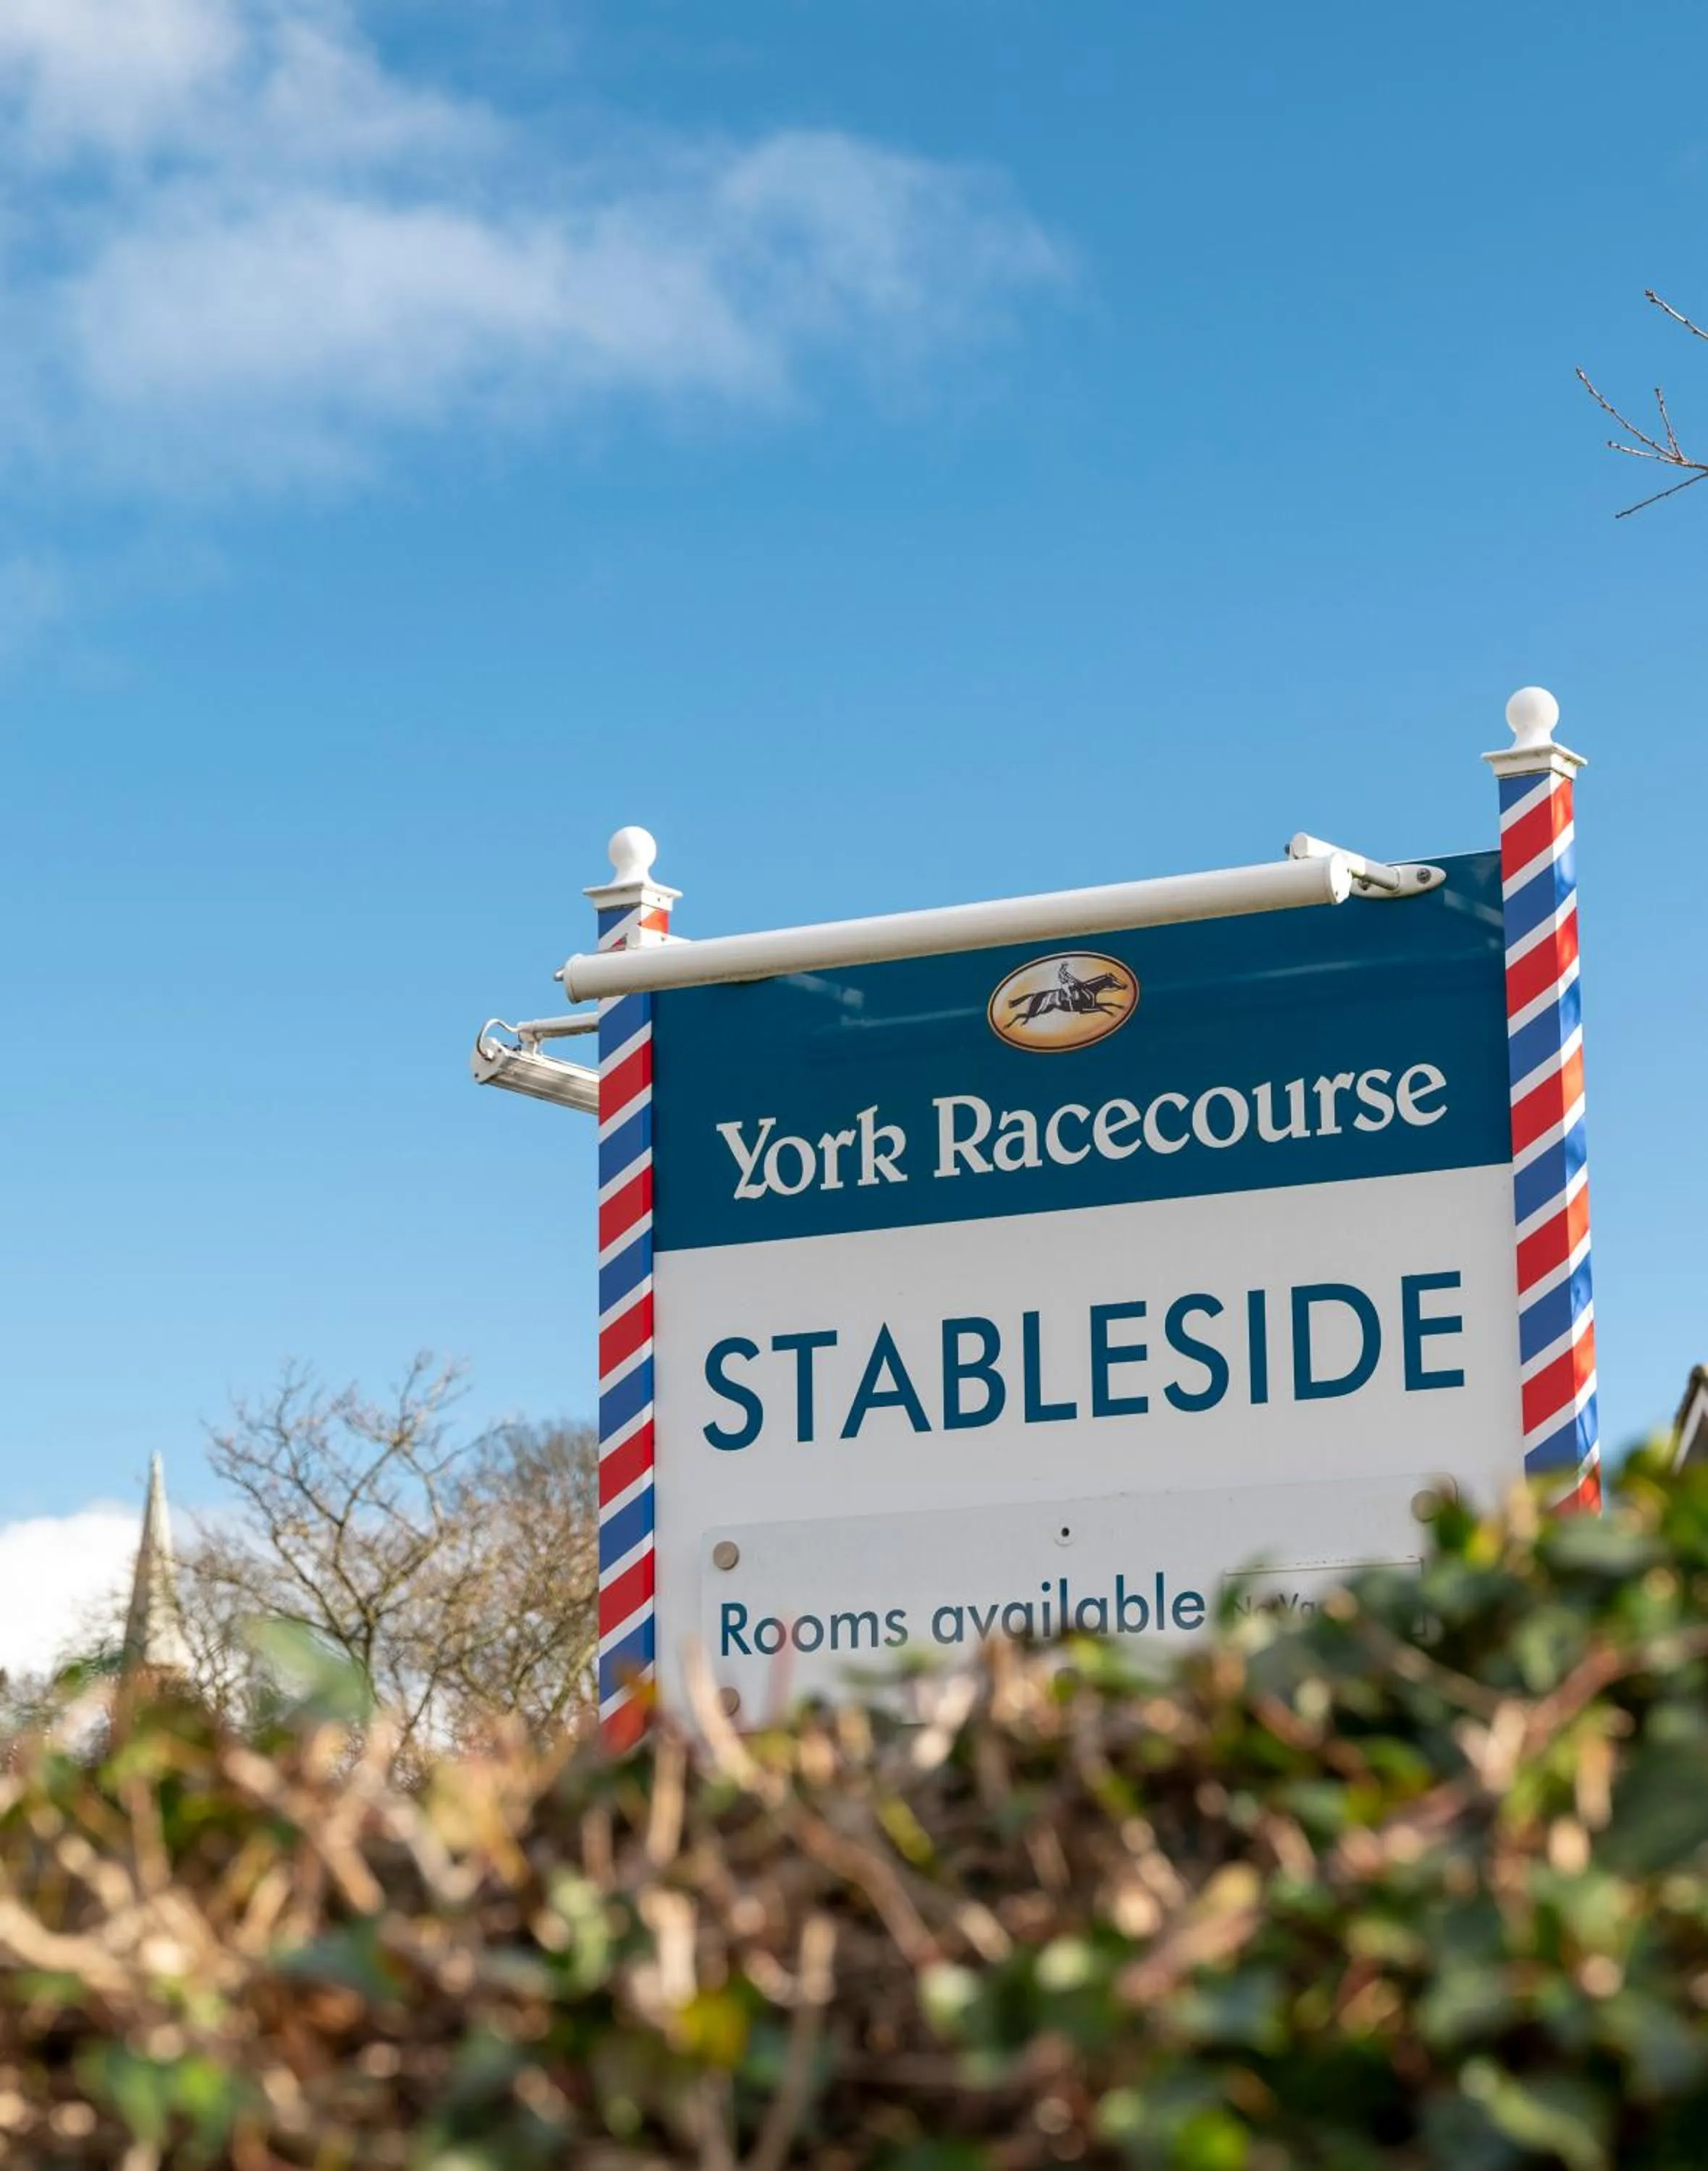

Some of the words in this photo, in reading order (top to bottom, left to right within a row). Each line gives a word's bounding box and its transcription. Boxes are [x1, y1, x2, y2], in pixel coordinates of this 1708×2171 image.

[716, 1104, 908, 1200] York
[932, 1062, 1447, 1179] Racecourse
[702, 1270, 1466, 1450] STABLESIDE
[720, 1602, 909, 1657] Rooms
[931, 1571, 1206, 1645] available
